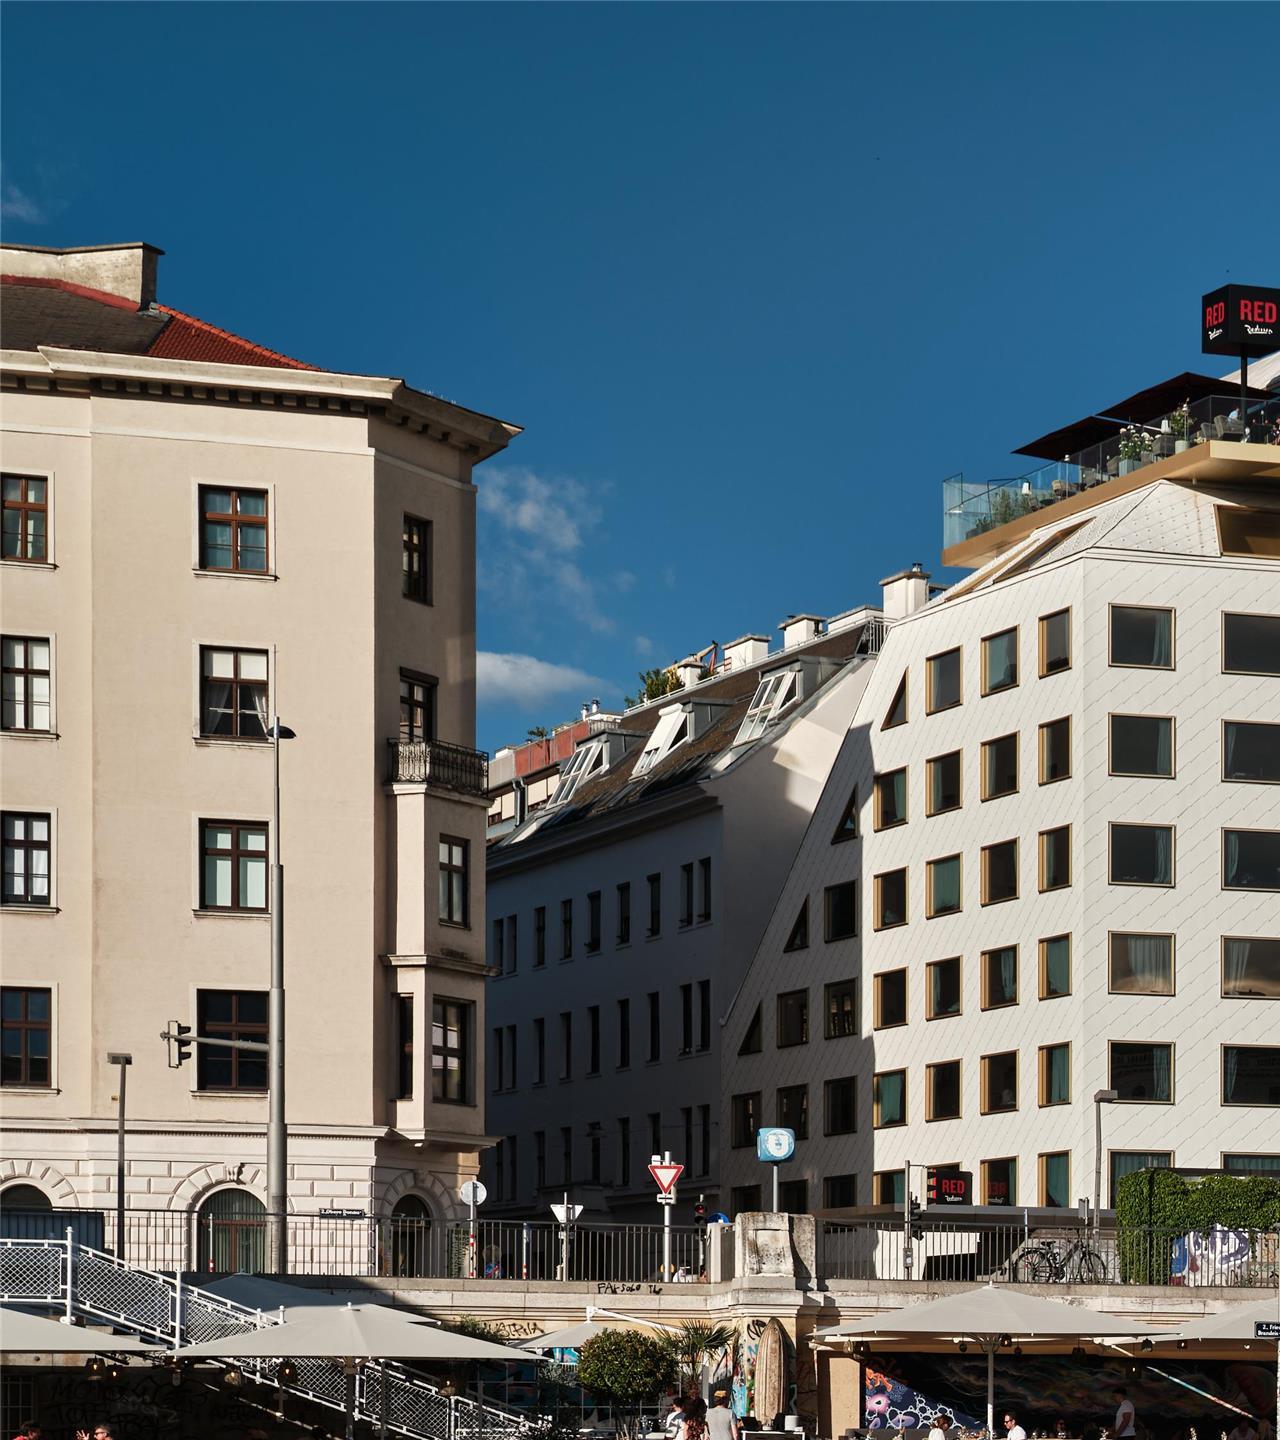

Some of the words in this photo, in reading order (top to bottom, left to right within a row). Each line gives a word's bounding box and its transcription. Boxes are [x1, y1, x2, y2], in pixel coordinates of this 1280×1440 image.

[1205, 302, 1225, 328] RED
[1239, 299, 1277, 324] RED
[942, 1179, 965, 1194] RED
